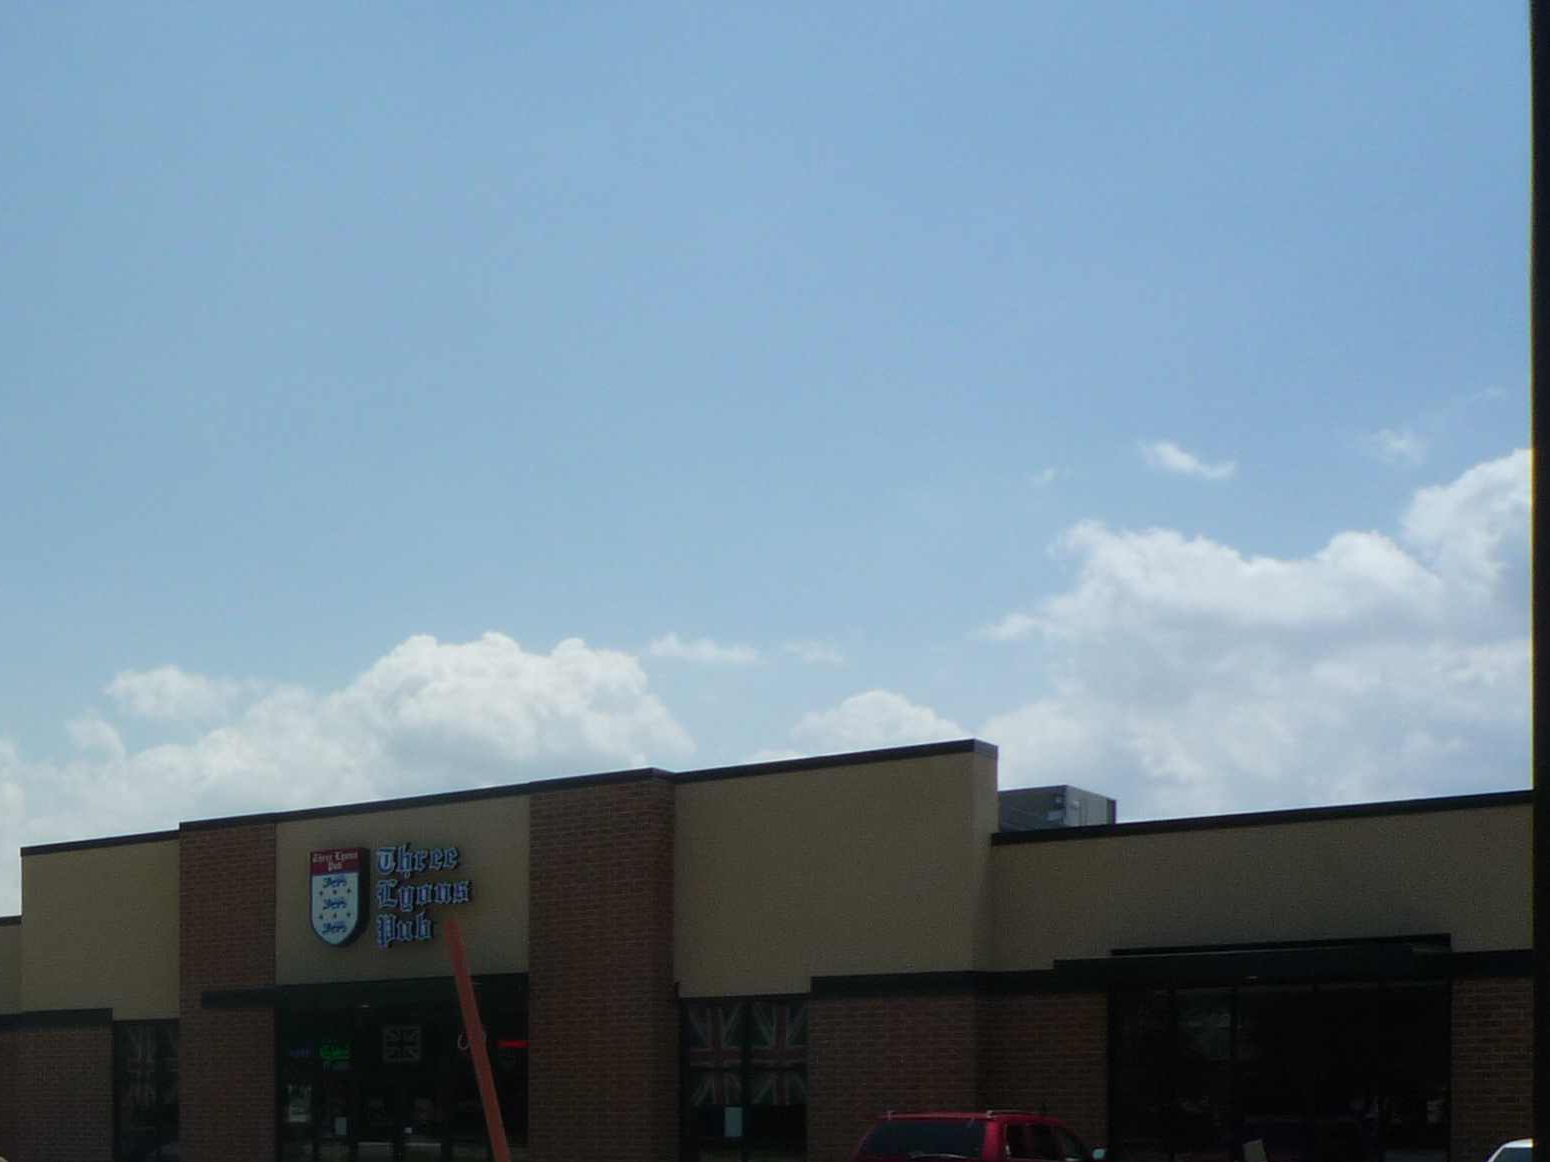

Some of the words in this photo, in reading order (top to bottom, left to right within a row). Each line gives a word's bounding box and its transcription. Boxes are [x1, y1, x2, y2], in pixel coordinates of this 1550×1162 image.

[375, 844, 459, 878] Three
[376, 879, 469, 912] Lyons
[375, 910, 434, 949] Pub
